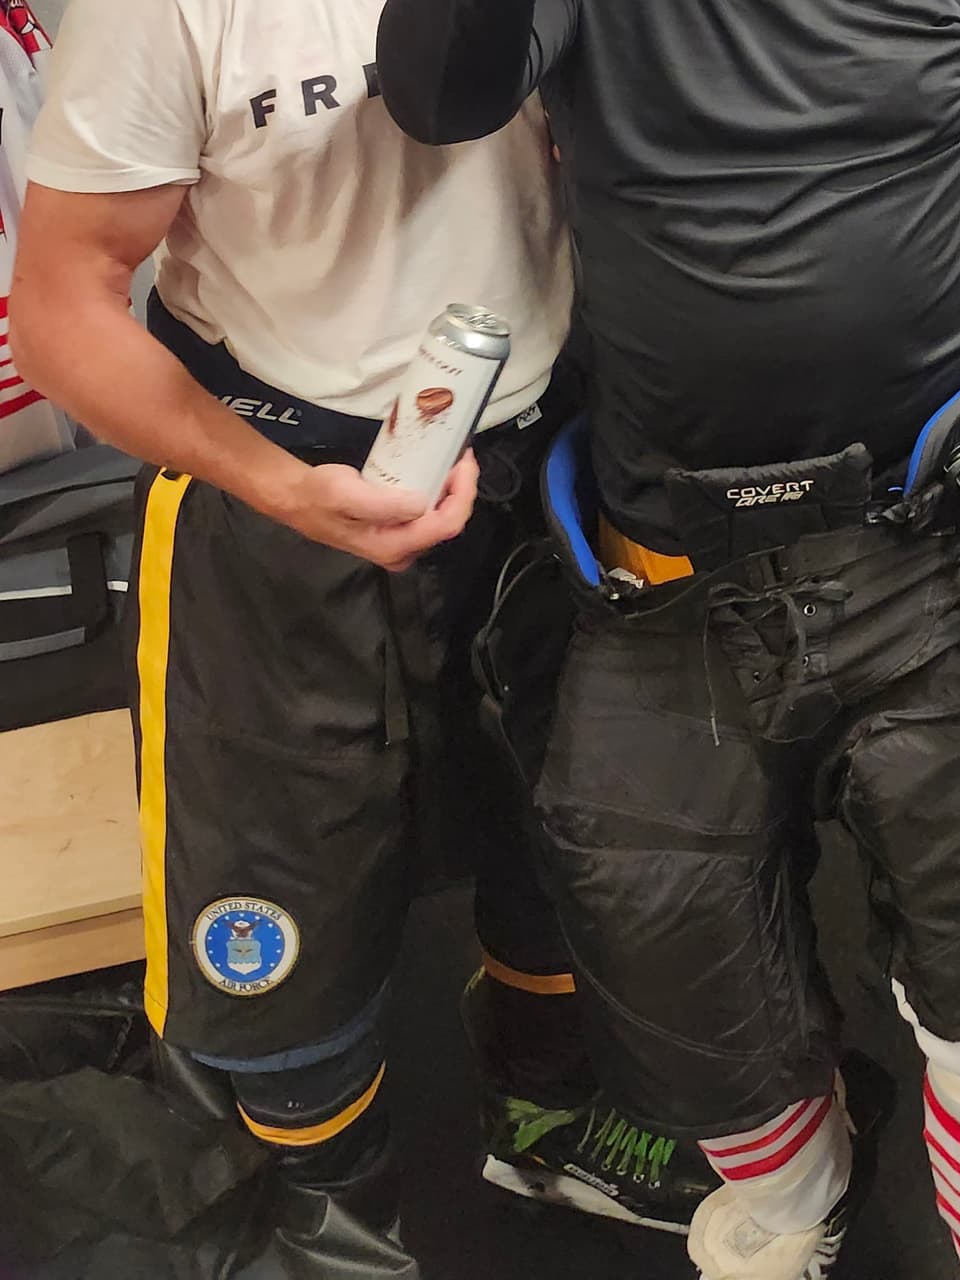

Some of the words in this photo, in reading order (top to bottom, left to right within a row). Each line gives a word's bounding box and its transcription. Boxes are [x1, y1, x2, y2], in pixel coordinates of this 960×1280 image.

[221, 396, 300, 426] ELL
[726, 480, 814, 499] COVERT
[206, 902, 242, 921] UNITED
[244, 902, 282, 921] STATES
[219, 979, 237, 990] AIR
[239, 977, 272, 992] FORCE
